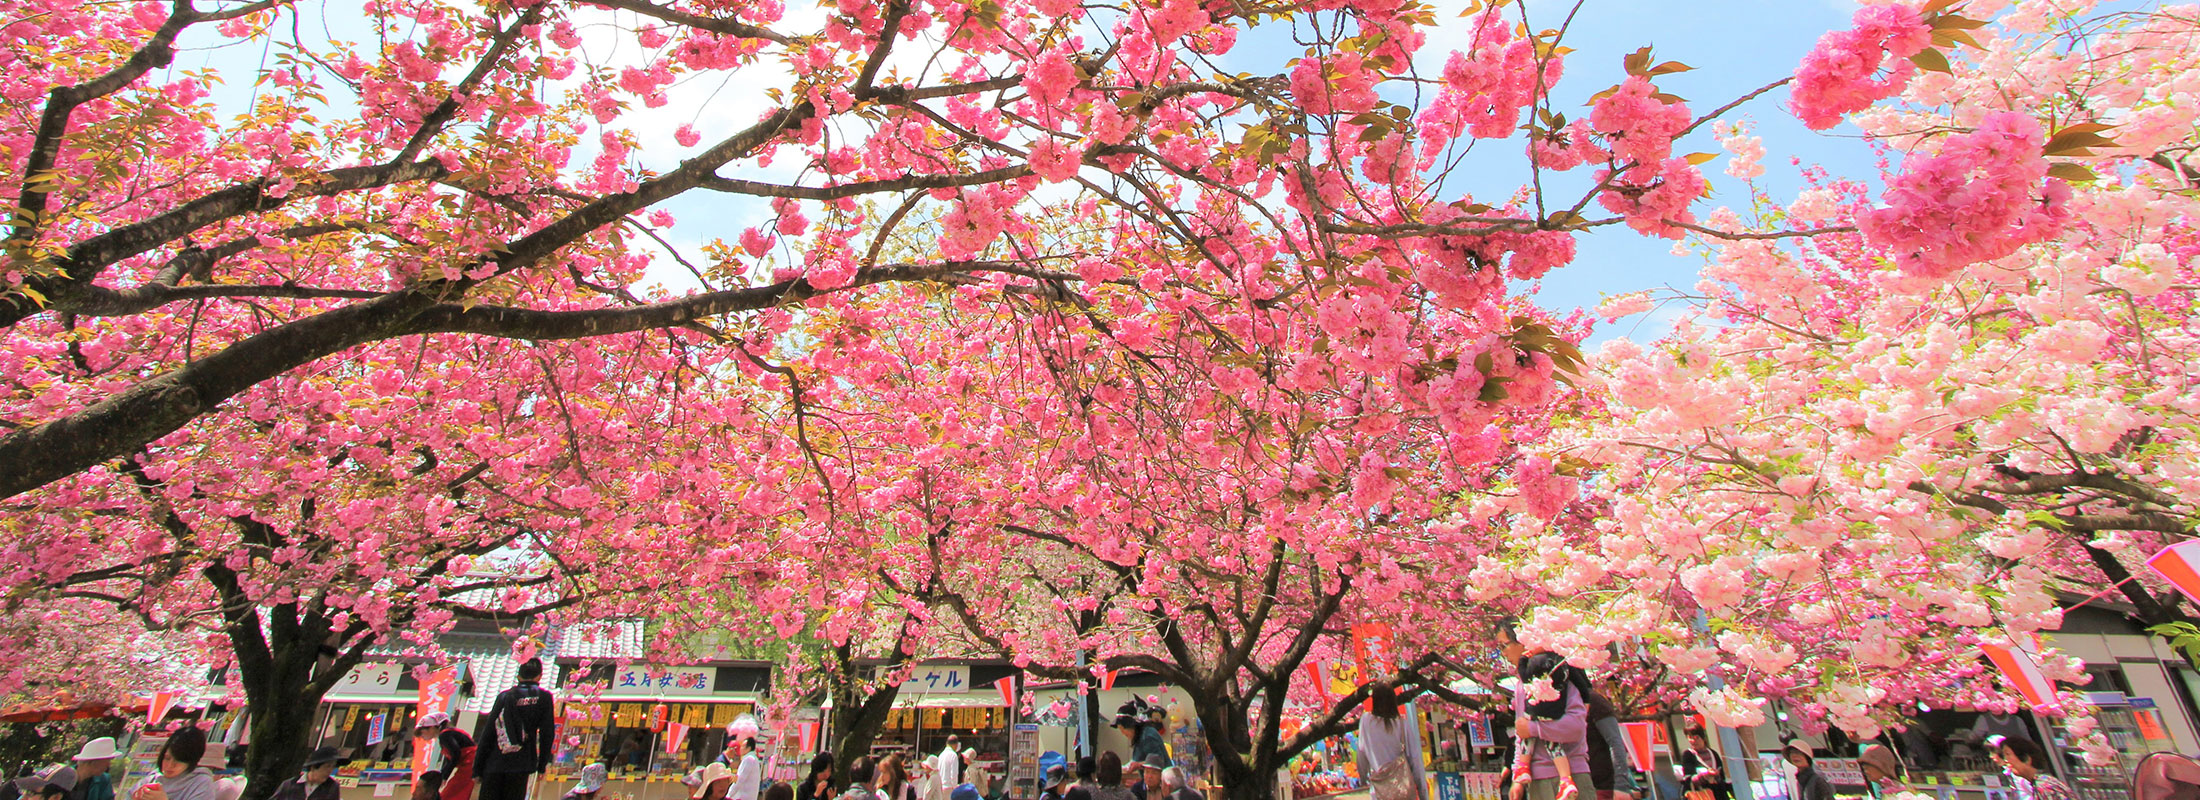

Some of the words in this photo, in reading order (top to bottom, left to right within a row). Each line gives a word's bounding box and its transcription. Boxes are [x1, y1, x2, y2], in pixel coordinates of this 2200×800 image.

[620, 671, 708, 689] 五月女店
[906, 670, 962, 688] ーゲル
